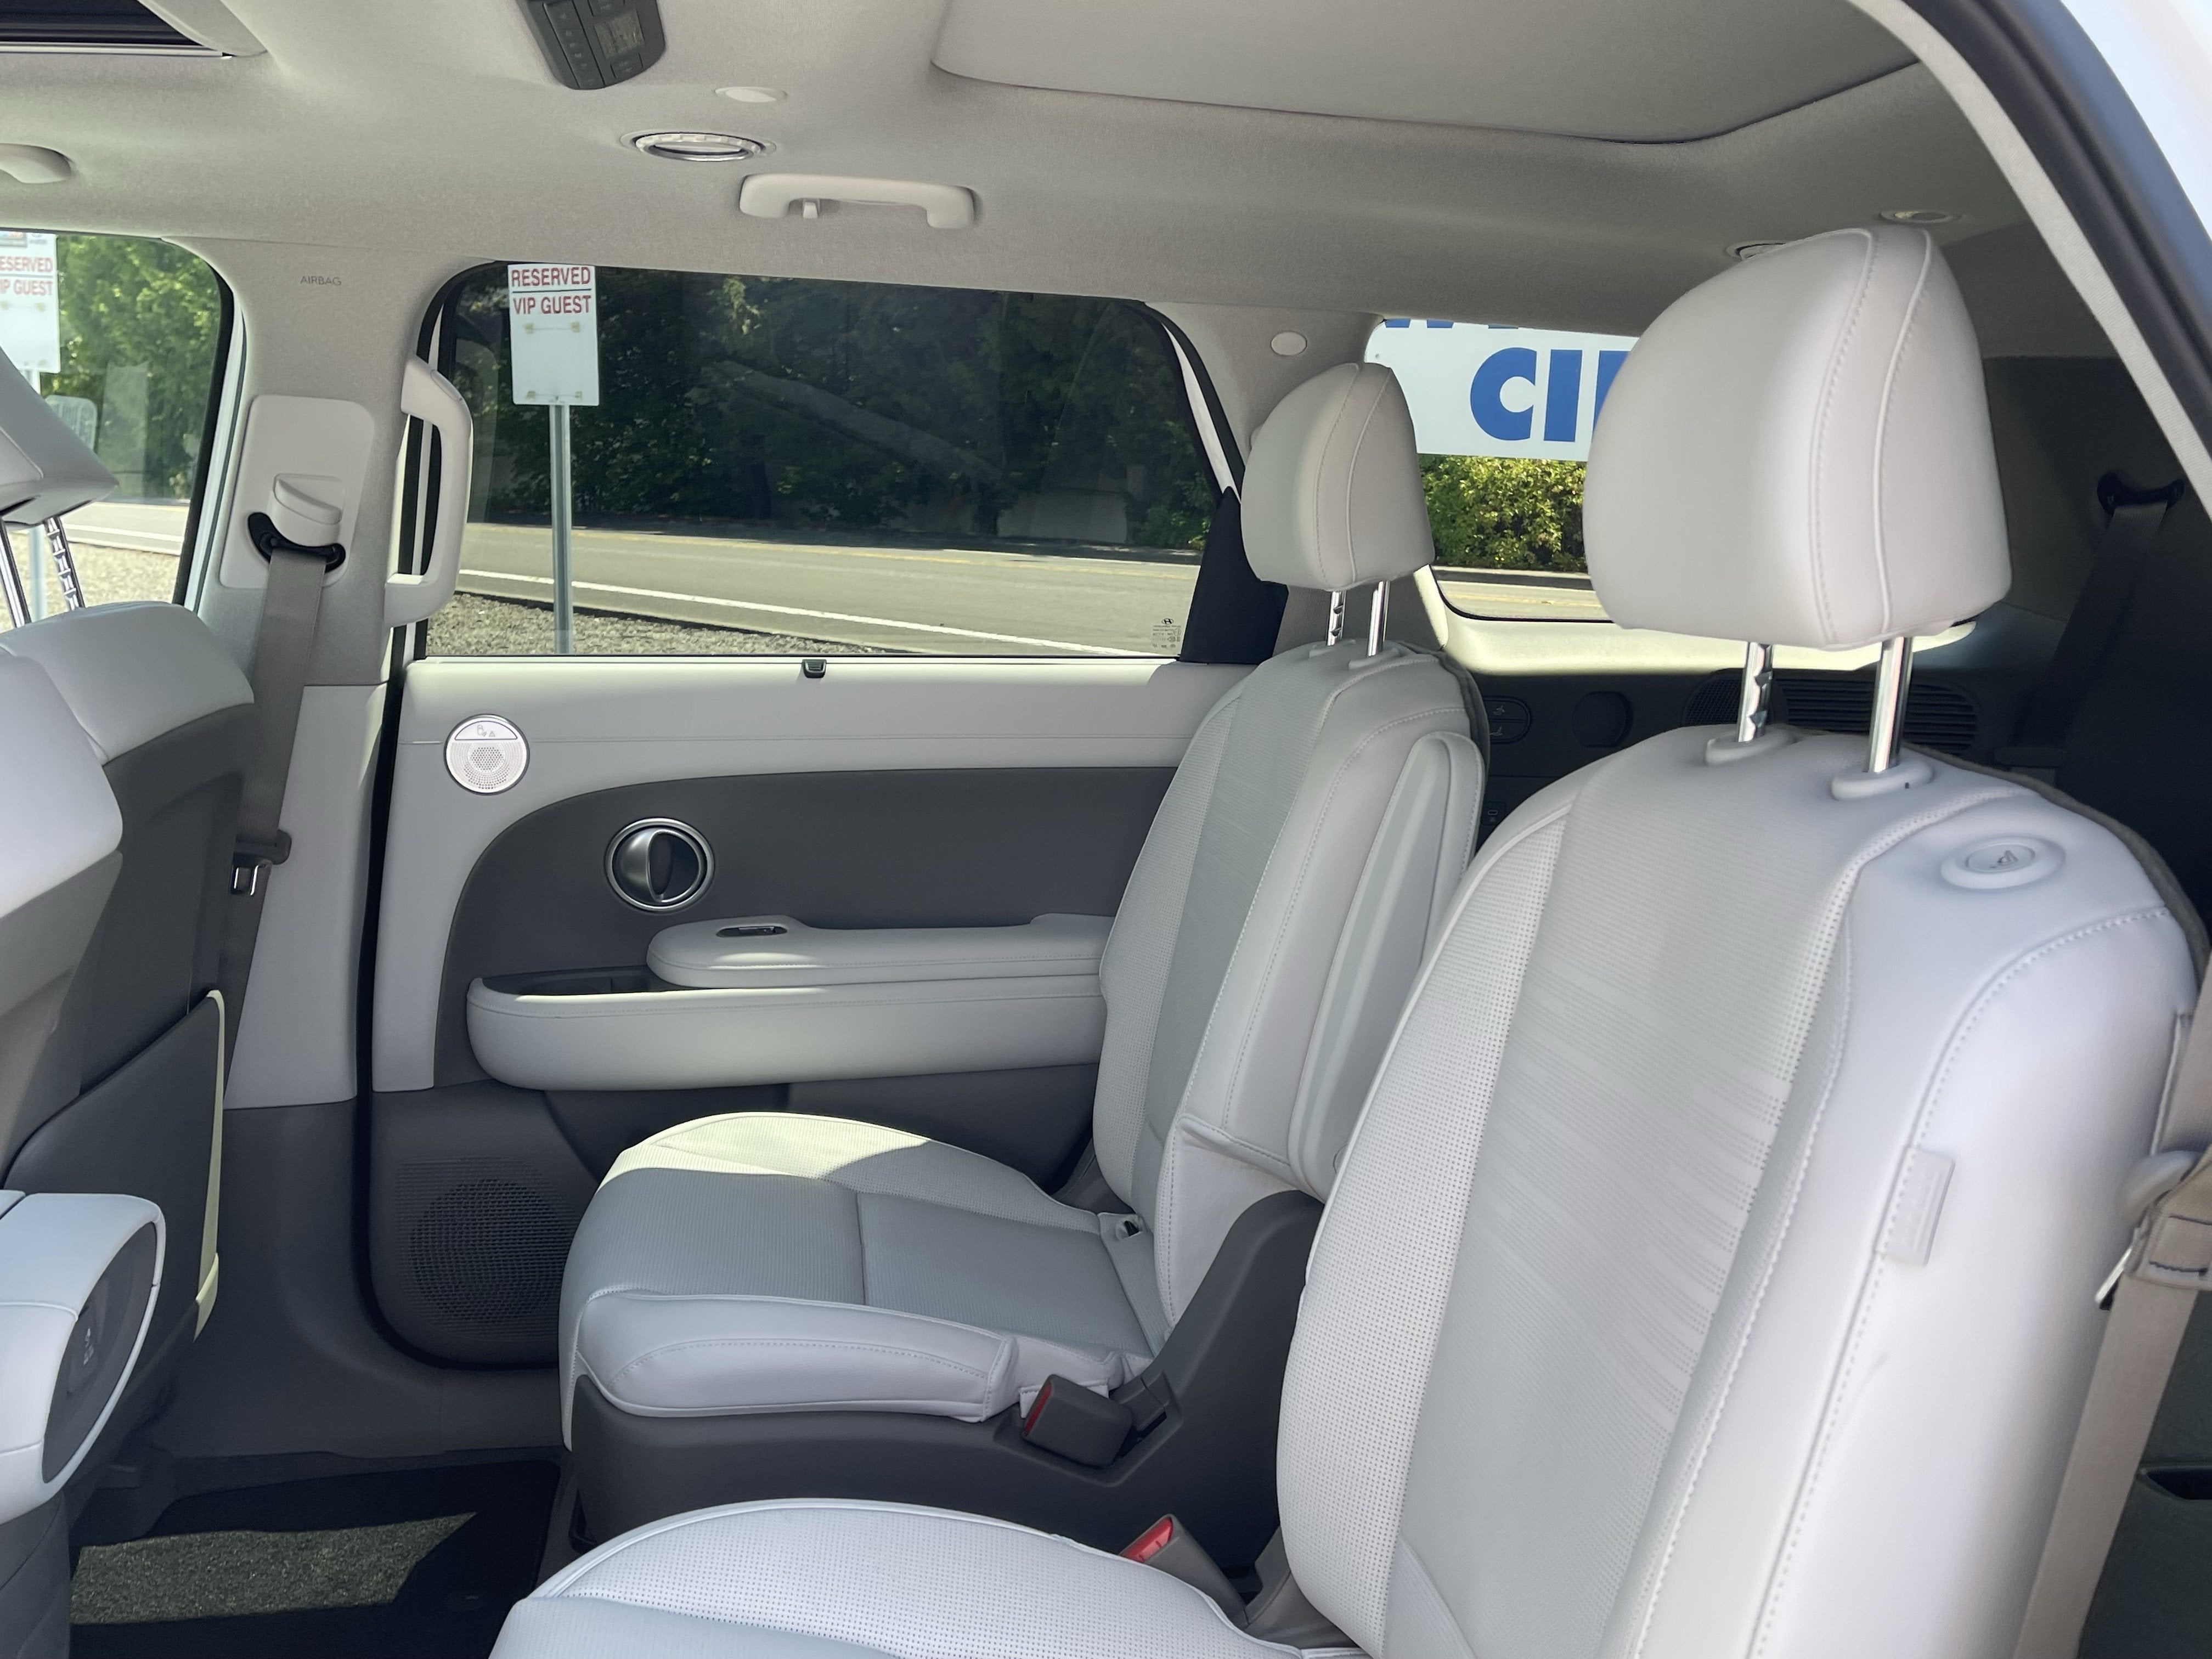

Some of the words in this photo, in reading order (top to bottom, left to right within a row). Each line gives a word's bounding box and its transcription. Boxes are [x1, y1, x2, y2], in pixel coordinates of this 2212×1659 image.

[0, 256, 53, 273] ESERVED
[300, 275, 342, 286] AIRBAG
[511, 266, 591, 287] RESERVED
[13, 279, 53, 295] GUEST
[513, 296, 536, 315] VIP
[540, 295, 591, 314] GUEST
